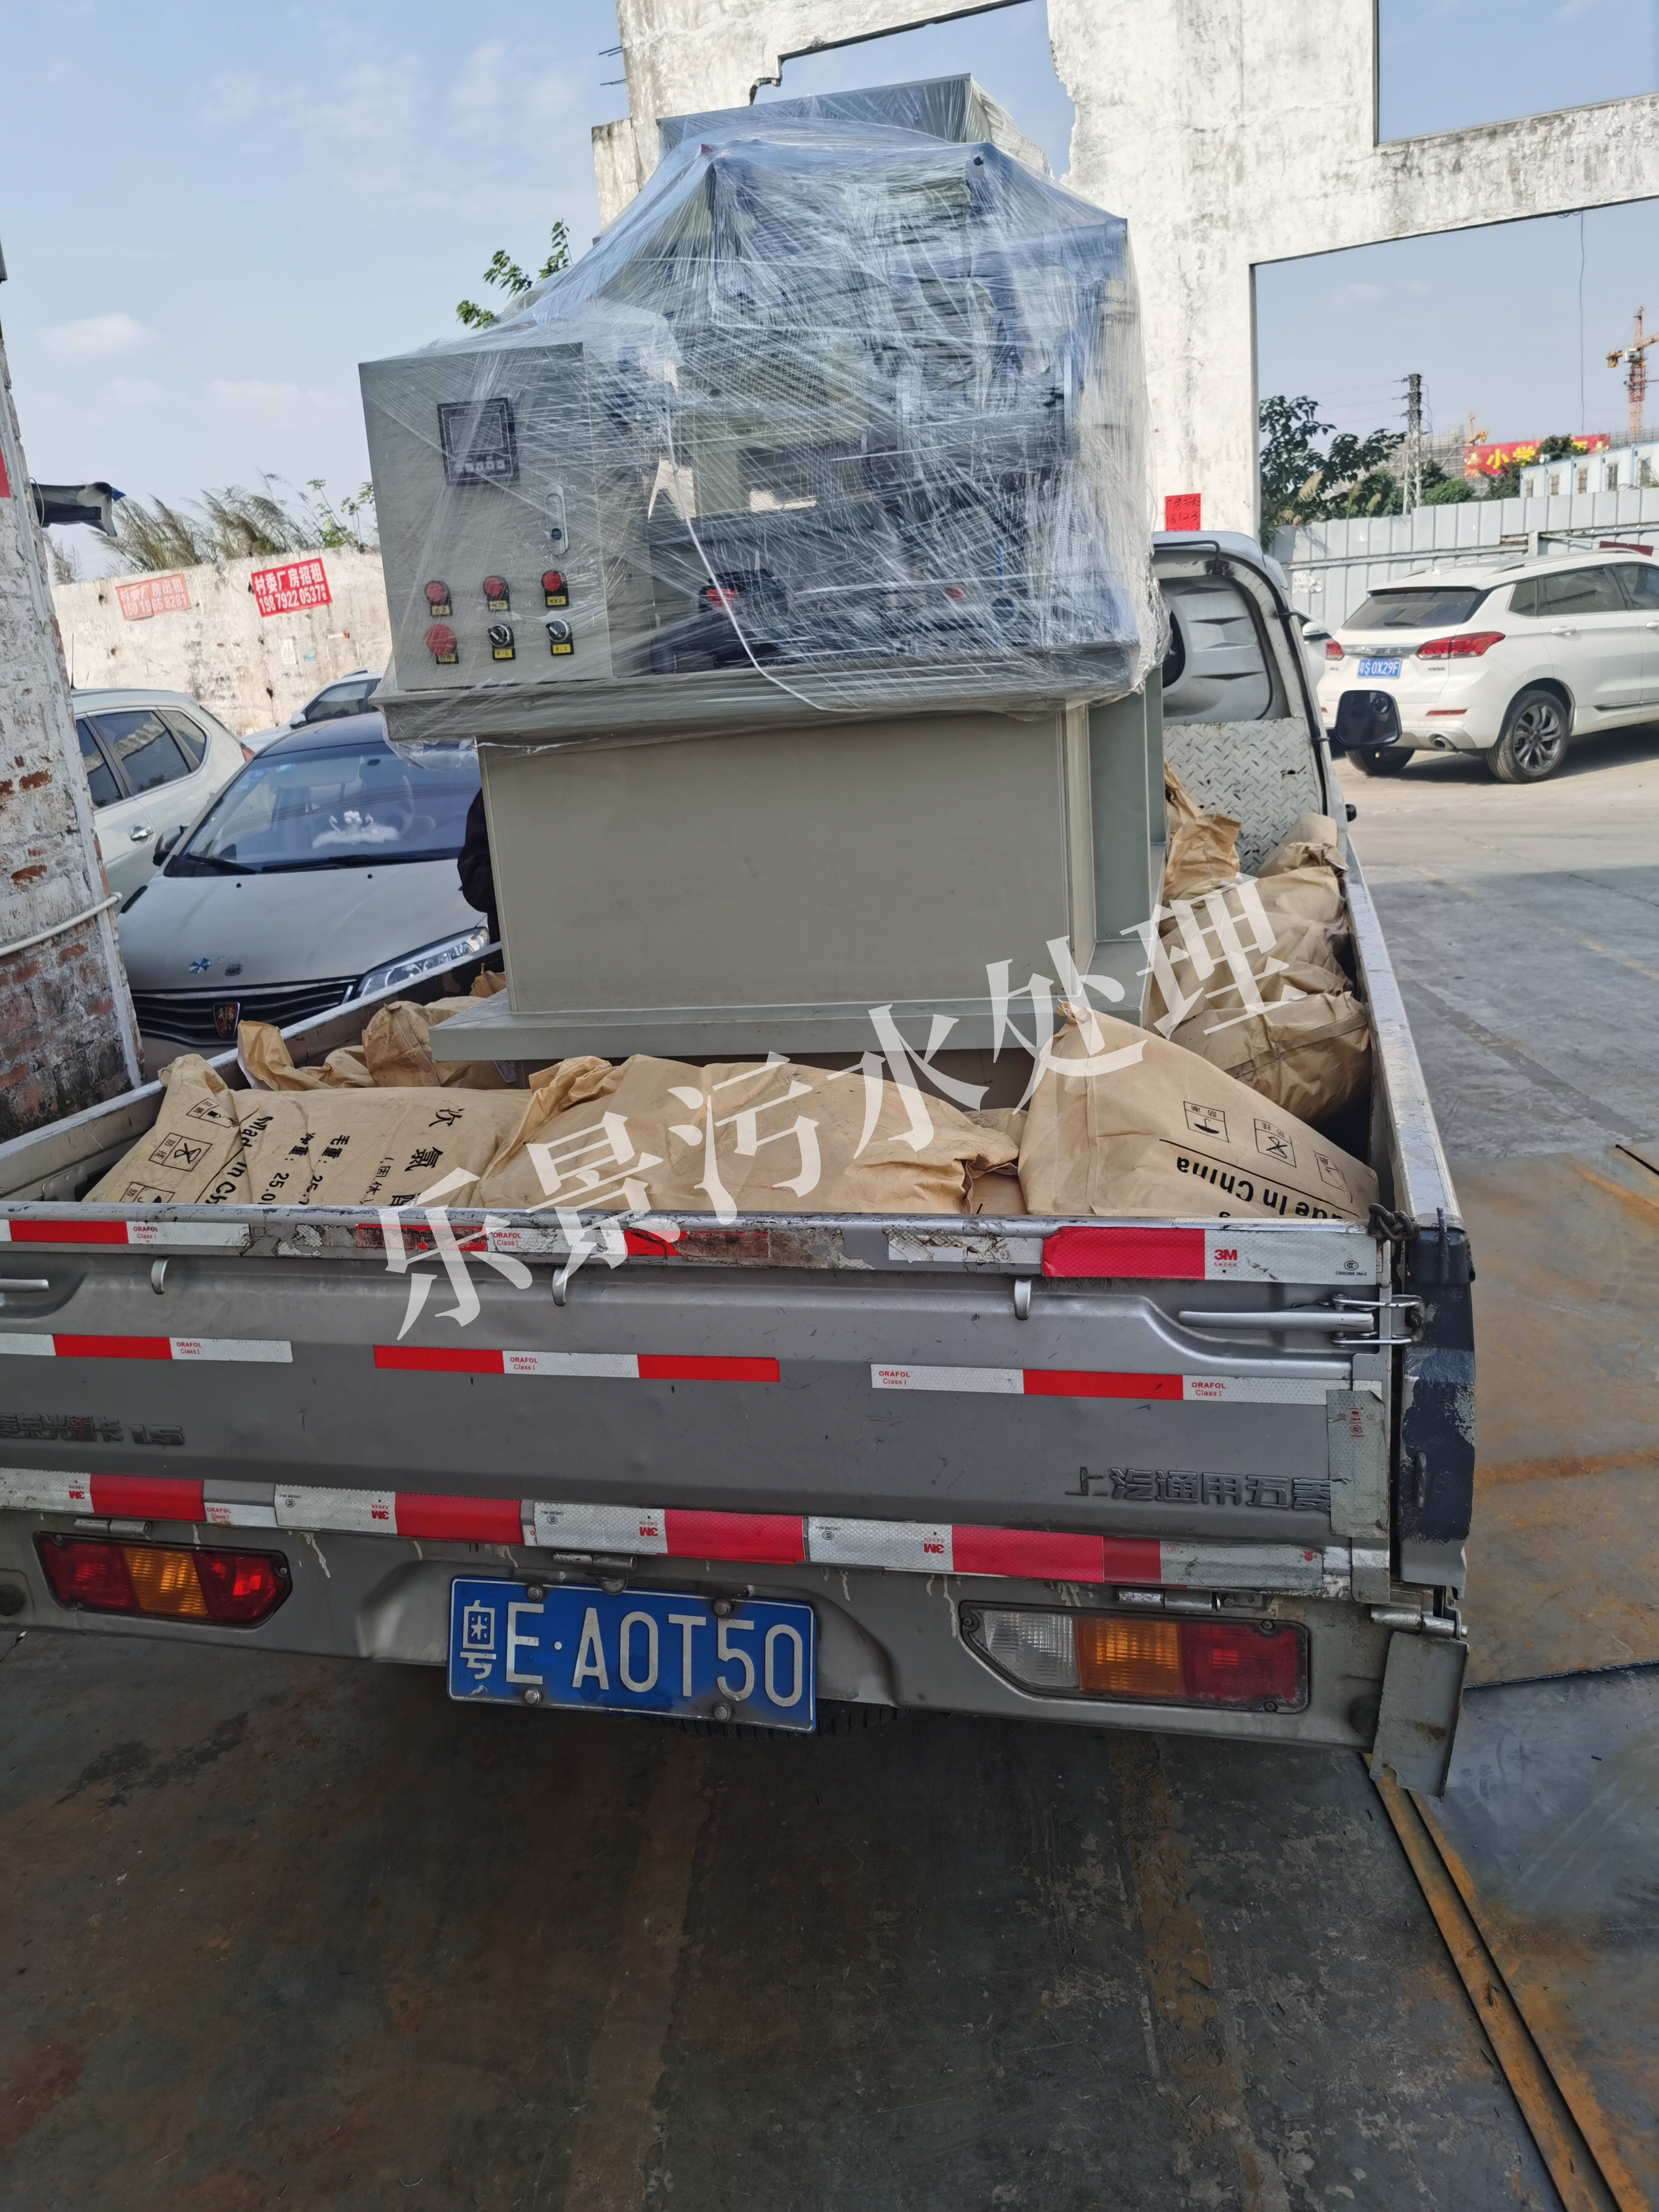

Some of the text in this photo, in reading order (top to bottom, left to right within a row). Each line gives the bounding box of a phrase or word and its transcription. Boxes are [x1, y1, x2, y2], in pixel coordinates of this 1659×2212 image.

[255, 563, 323, 595] 村委厂房招租
[119, 578, 184, 602] 村委厂房出租
[123, 602, 138, 616] 150
[164, 594, 187, 609] 8281
[259, 594, 276, 613] 198
[275, 589, 300, 609] 7922
[299, 585, 321, 605] 0537
[1214, 1249, 1238, 1261] 3M
[69, 1490, 85, 1500] 3M
[1065, 1466, 1332, 1511] 上汽通用五菱
[371, 1510, 389, 1520] 3M
[639, 1526, 659, 1537] 3M
[923, 1543, 945, 1554] 3M
